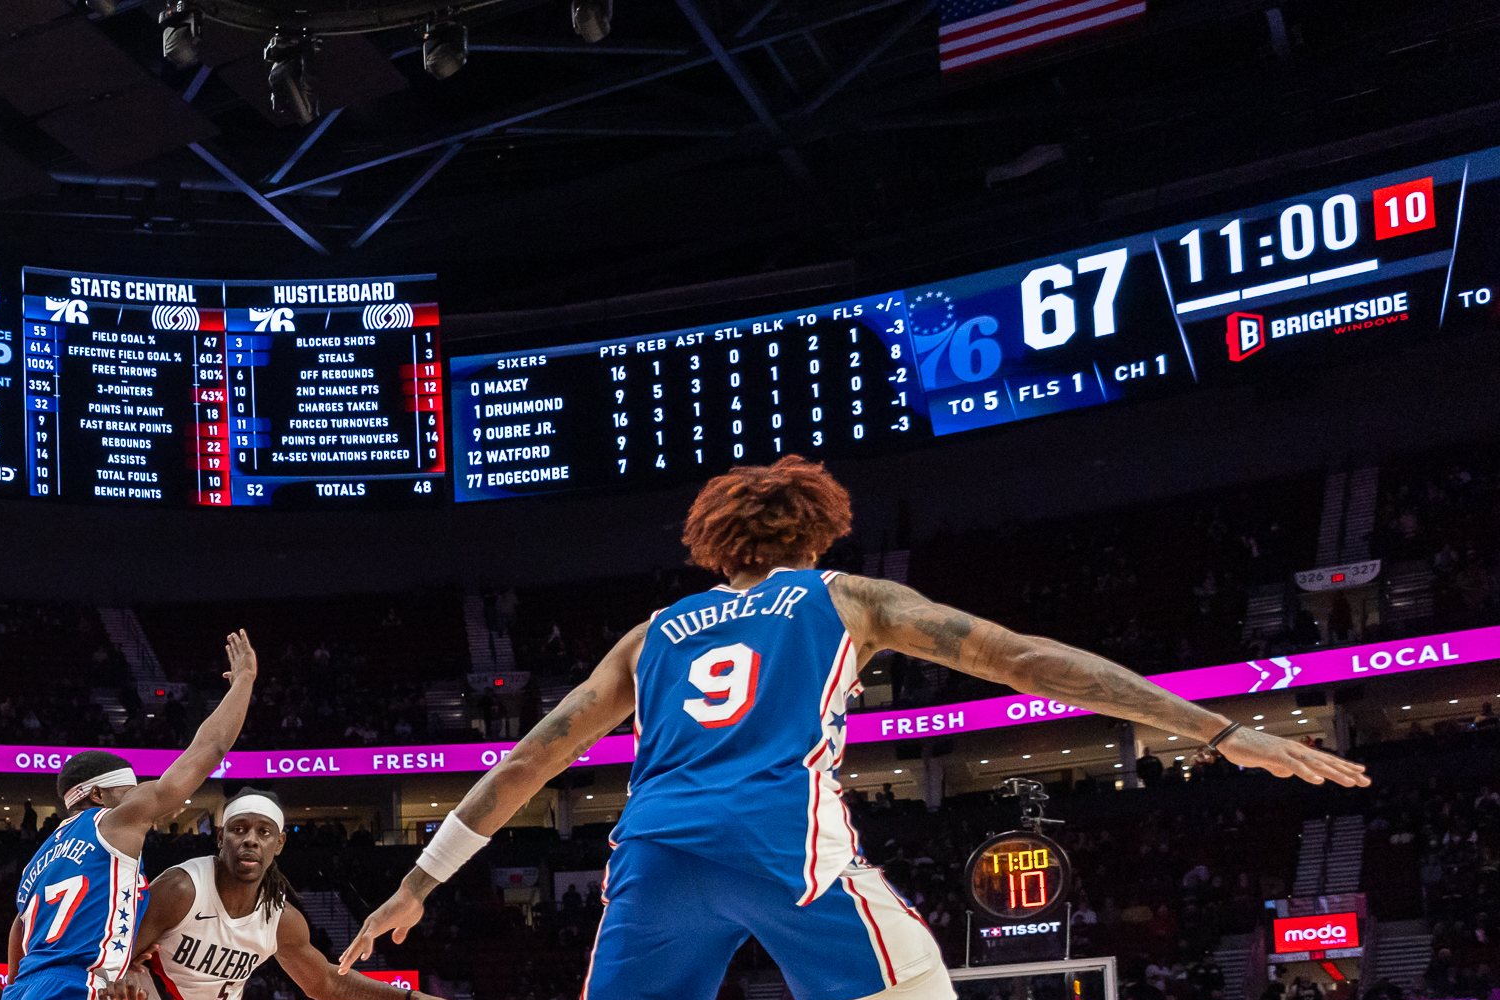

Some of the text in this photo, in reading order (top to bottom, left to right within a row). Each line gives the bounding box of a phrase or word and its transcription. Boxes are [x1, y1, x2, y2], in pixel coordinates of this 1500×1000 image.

[1385, 192, 1426, 227] 10
[1180, 194, 1360, 284] 11:00
[71, 278, 196, 302] STATS CENTRAL
[274, 282, 394, 303] HUSTLEBOARD
[1021, 248, 1127, 350] 67
[1458, 288, 1490, 307] TO
[1272, 293, 1407, 338] BRIGHTSIDE
[1333, 313, 1409, 335] WINDOWS
[33, 325, 218, 348] 55 FIELD GOAL % 47
[600, 345, 626, 357] PTS
[637, 339, 666, 352] REB
[676, 333, 704, 346] AST
[715, 328, 742, 340] STL
[753, 319, 783, 334] BLK
[797, 314, 816, 326] TO
[834, 305, 862, 320] FLS
[297, 336, 375, 347] BLOCKED SHOTS
[30, 341, 223, 364] 61.4 EFFECTIVE FIELD GOAL % 60.2
[319, 353, 354, 362] STEALS
[498, 355, 546, 369] SIXERS
[26, 357, 224, 381] 100% FREE THROWS 80%
[301, 369, 373, 379] OFF REBOUNDS
[1115, 356, 1165, 380] CH 1
[28, 379, 224, 402] 35% 3-POINTERS 43%
[297, 385, 379, 395] 2ND CHANCE PTS
[471, 378, 528, 396] 0 MAXEY
[1019, 373, 1081, 401] FLS 1
[34, 398, 163, 416] 32 POINTS IN PAINT
[299, 402, 377, 412] CHARGES TAKEN
[475, 398, 562, 418] 1 DRUMMOND
[948, 391, 998, 414] TO 5
[81, 419, 172, 433] FAST BREAK POINTS
[290, 418, 388, 428] FORCED TURNOVERS
[473, 422, 555, 441] 9 OUBRE JR.
[102, 437, 151, 448] REBOUNDS
[282, 434, 398, 445] POINTS OFF TURNOVERS
[108, 454, 146, 464] ASSISTS
[272, 450, 409, 461] 24-SEC VIOLATIONS FORCED
[468, 445, 549, 465] 12 WATFORD
[97, 470, 157, 482] TOTAL FOULS
[467, 466, 568, 488] 77 EDGECOMBE
[95, 486, 161, 498] BENCH POINTS
[247, 481, 431, 496] 52 TOTALS 48
[1351, 563, 1377, 577] 327
[660, 586, 808, 645] OUBRE JR.
[1352, 643, 1459, 672] LOCAL
[683, 643, 761, 729] 9
[882, 711, 964, 735] FRESH
[267, 757, 340, 773] LOCAL
[374, 753, 444, 769] FRESH
[17, 838, 96, 904] EDGECOMBE
[993, 849, 1049, 874] 11:00
[1008, 871, 1047, 909] 10
[1002, 922, 1061, 936] TISSOT
[1285, 924, 1347, 942] moda
[172, 934, 260, 980] BLAZERS
